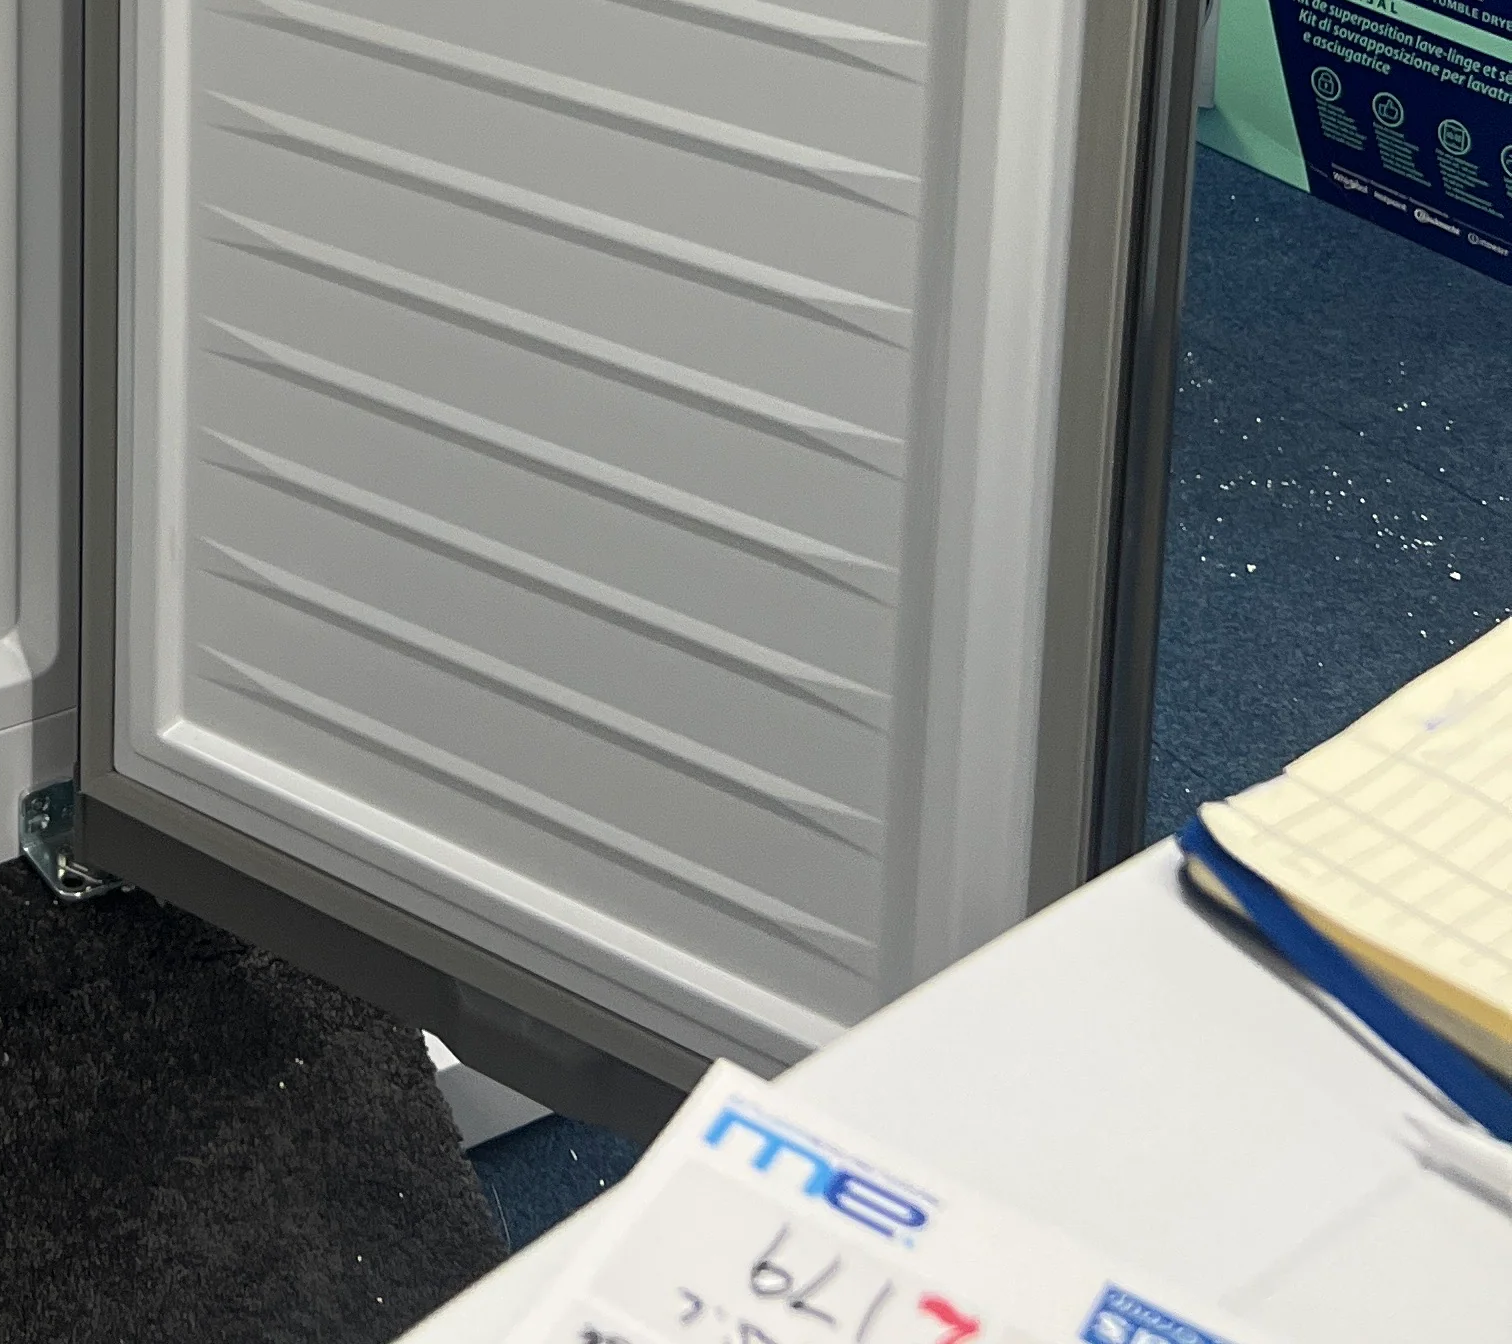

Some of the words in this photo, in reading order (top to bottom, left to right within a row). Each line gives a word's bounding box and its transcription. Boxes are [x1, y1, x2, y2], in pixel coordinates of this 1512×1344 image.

[1298, 8, 1317, 26] Kit
[1318, 15, 1331, 33] di
[1333, 25, 1441, 77] sovrapposizione
[1440, 68, 1466, 86] per
[1303, 30, 1311, 43] e
[1312, 36, 1391, 75] asciugatrice
[1329, 5, 1414, 47] superposition
[1415, 35, 1482, 73] lave-linge
[1482, 65, 1497, 79] et
